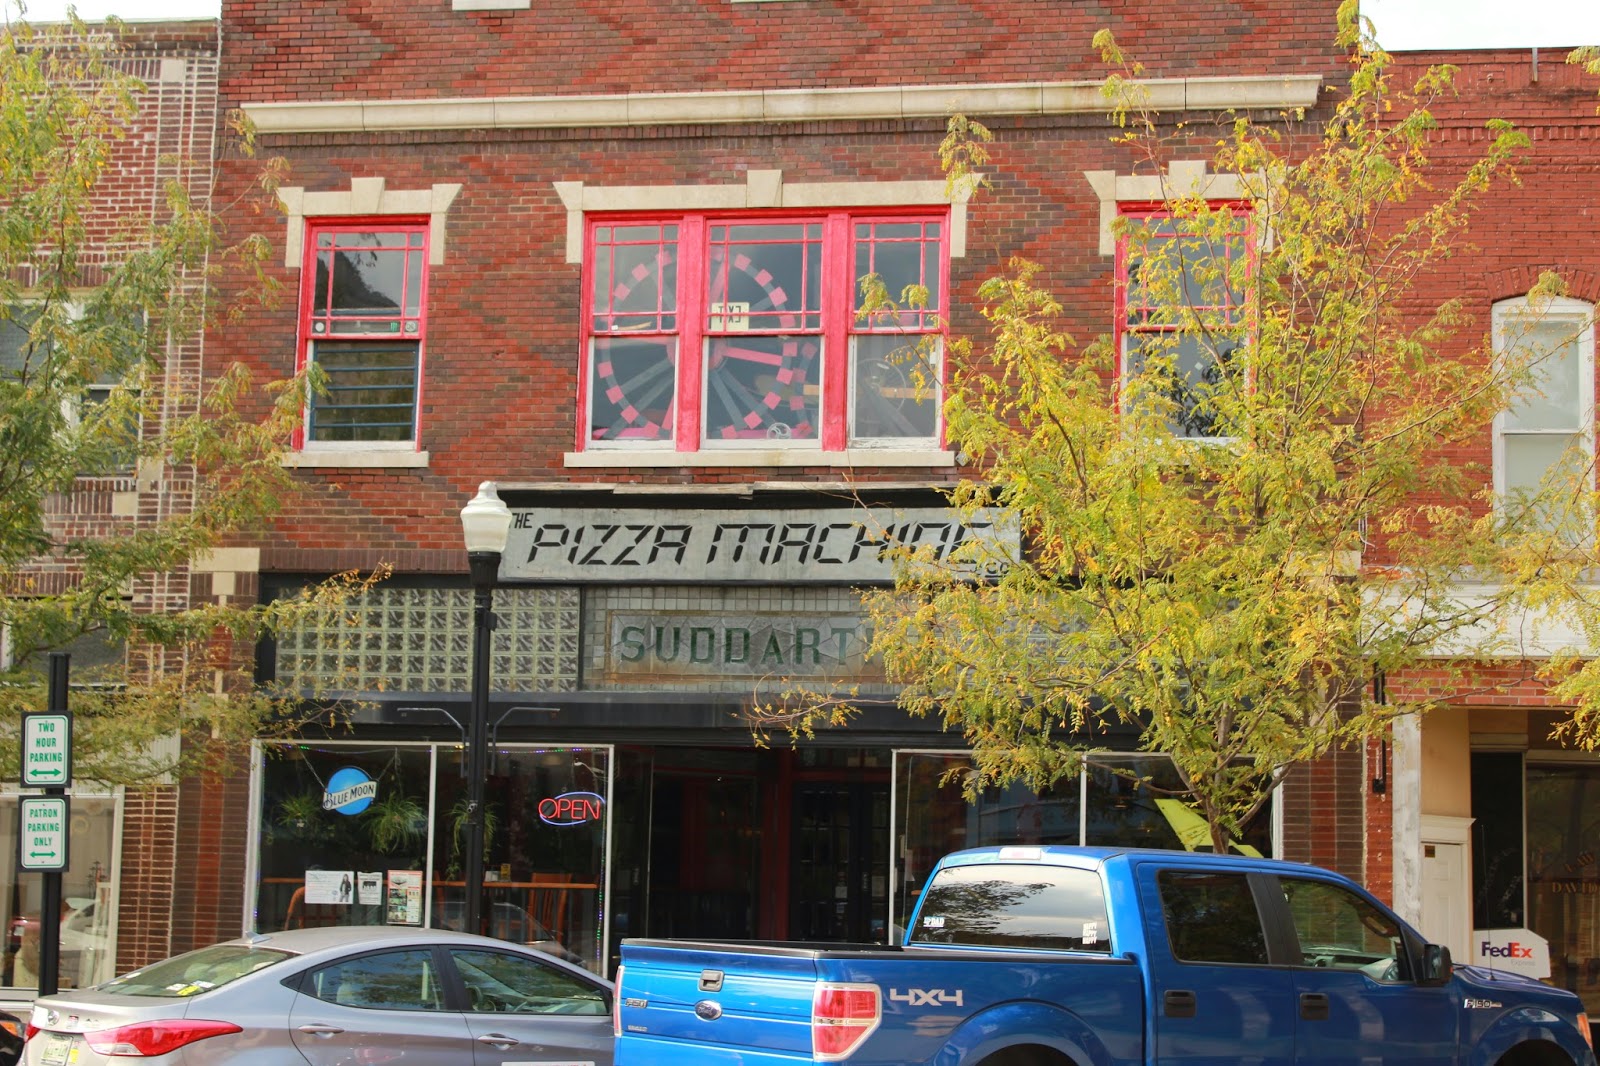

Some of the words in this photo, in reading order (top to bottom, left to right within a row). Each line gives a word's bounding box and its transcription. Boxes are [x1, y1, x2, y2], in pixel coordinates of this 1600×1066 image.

[527, 523, 693, 566] PIZZA
[706, 522, 993, 565] MACHINE
[38, 722, 55, 733] TWO
[36, 737, 57, 748] HOUR
[29, 752, 63, 763] PARKING
[323, 791, 349, 810] BLUE
[350, 784, 375, 799] MOON
[29, 808, 58, 818] PATRON
[538, 798, 601, 820] OPEN
[27, 823, 60, 833] PARKING
[33, 837, 53, 847] ONLY
[1481, 941, 1533, 958] FedEx
